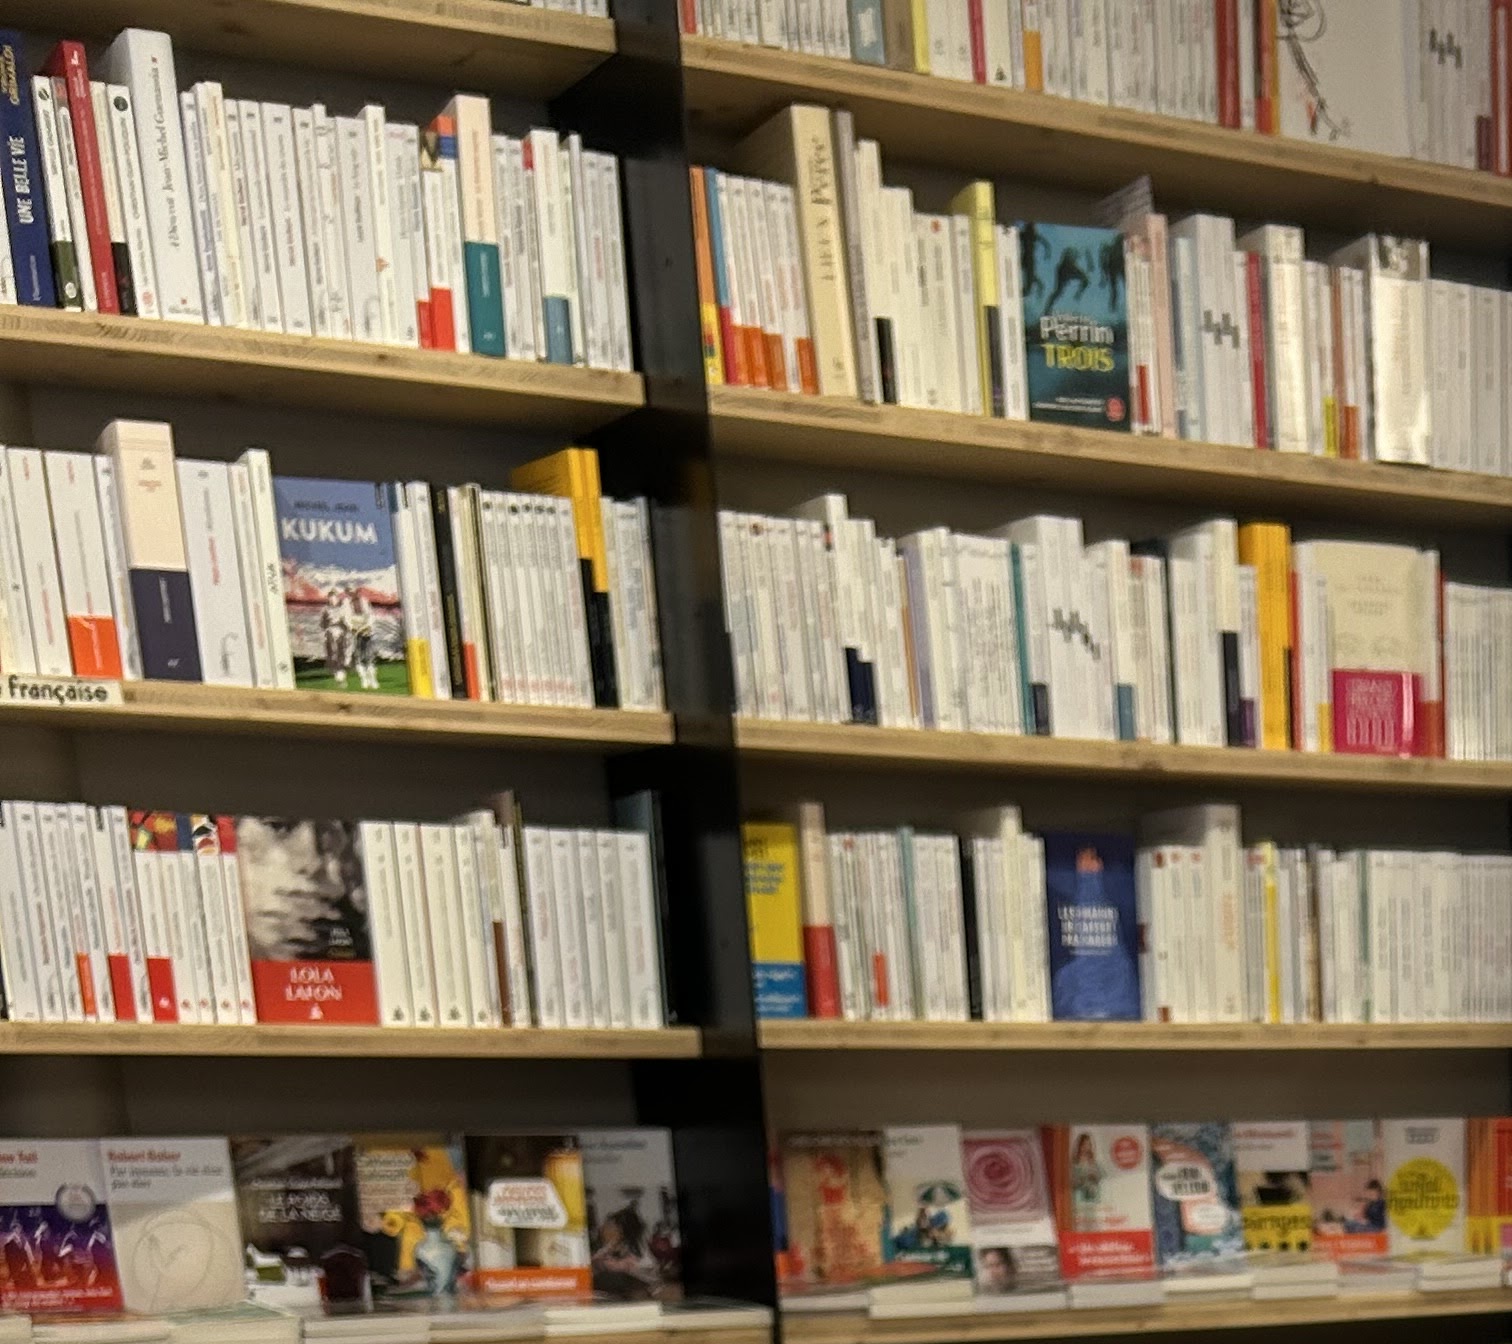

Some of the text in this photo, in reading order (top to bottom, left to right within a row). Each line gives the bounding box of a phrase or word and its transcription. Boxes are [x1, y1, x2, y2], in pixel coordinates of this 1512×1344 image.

[9, 135, 35, 225] UNE BELLE VIE
[1042, 343, 1115, 371] TROIS
[281, 518, 378, 545] KUKUM
[290, 966, 334, 983] LOLA
[285, 984, 342, 1001] LAFON
